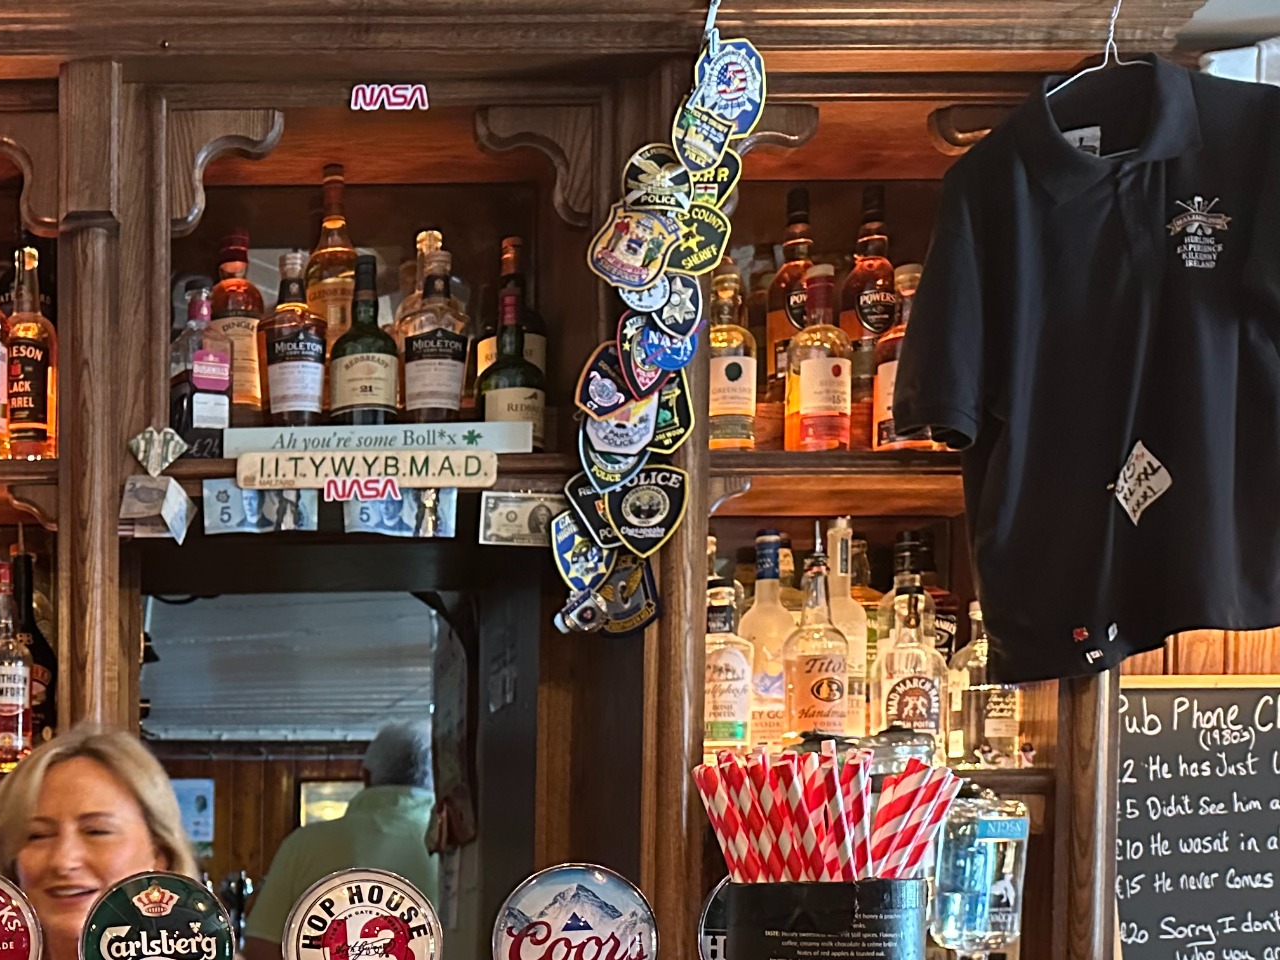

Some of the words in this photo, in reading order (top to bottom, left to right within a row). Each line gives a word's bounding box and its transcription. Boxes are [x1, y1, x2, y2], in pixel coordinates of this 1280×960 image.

[354, 86, 426, 107] NASA
[641, 194, 677, 205] POLICE
[692, 208, 727, 232] COUNTY
[682, 244, 718, 269] SHERIFF
[860, 291, 896, 305] POWERS
[274, 342, 322, 353] MIDLETON
[413, 339, 462, 351] MIDLETON
[344, 354, 389, 370] REDBREAST
[360, 384, 373, 393] 21
[272, 433, 297, 449] Ah
[302, 432, 352, 451] you're
[356, 435, 397, 447] some
[603, 435, 635, 447] POLICE
[609, 427, 630, 438] PARK
[260, 455, 488, 478] I.I.T.Y.W.Y.B.M.A.D.
[591, 465, 622, 481] POLICE
[326, 478, 399, 499] NASA
[220, 506, 232, 523] 5
[359, 506, 370, 522] 5
[887, 692, 901, 715] MAD
[900, 677, 928, 693] MARCH
[1173, 697, 1243, 730] Phone
[1149, 755, 1172, 781] He
[1179, 754, 1211, 777] has
[1216, 752, 1259, 777] Just
[1146, 794, 1194, 820] Didn't
[1198, 796, 1228, 816] See
[1232, 791, 1262, 812] him
[1150, 832, 1172, 857] He
[1240, 833, 1260, 853] in
[1153, 871, 1174, 893] He
[1179, 872, 1219, 891] never
[301, 897, 335, 950] HOP
[347, 885, 428, 941] HOUSE
[1217, 916, 1237, 933] I
